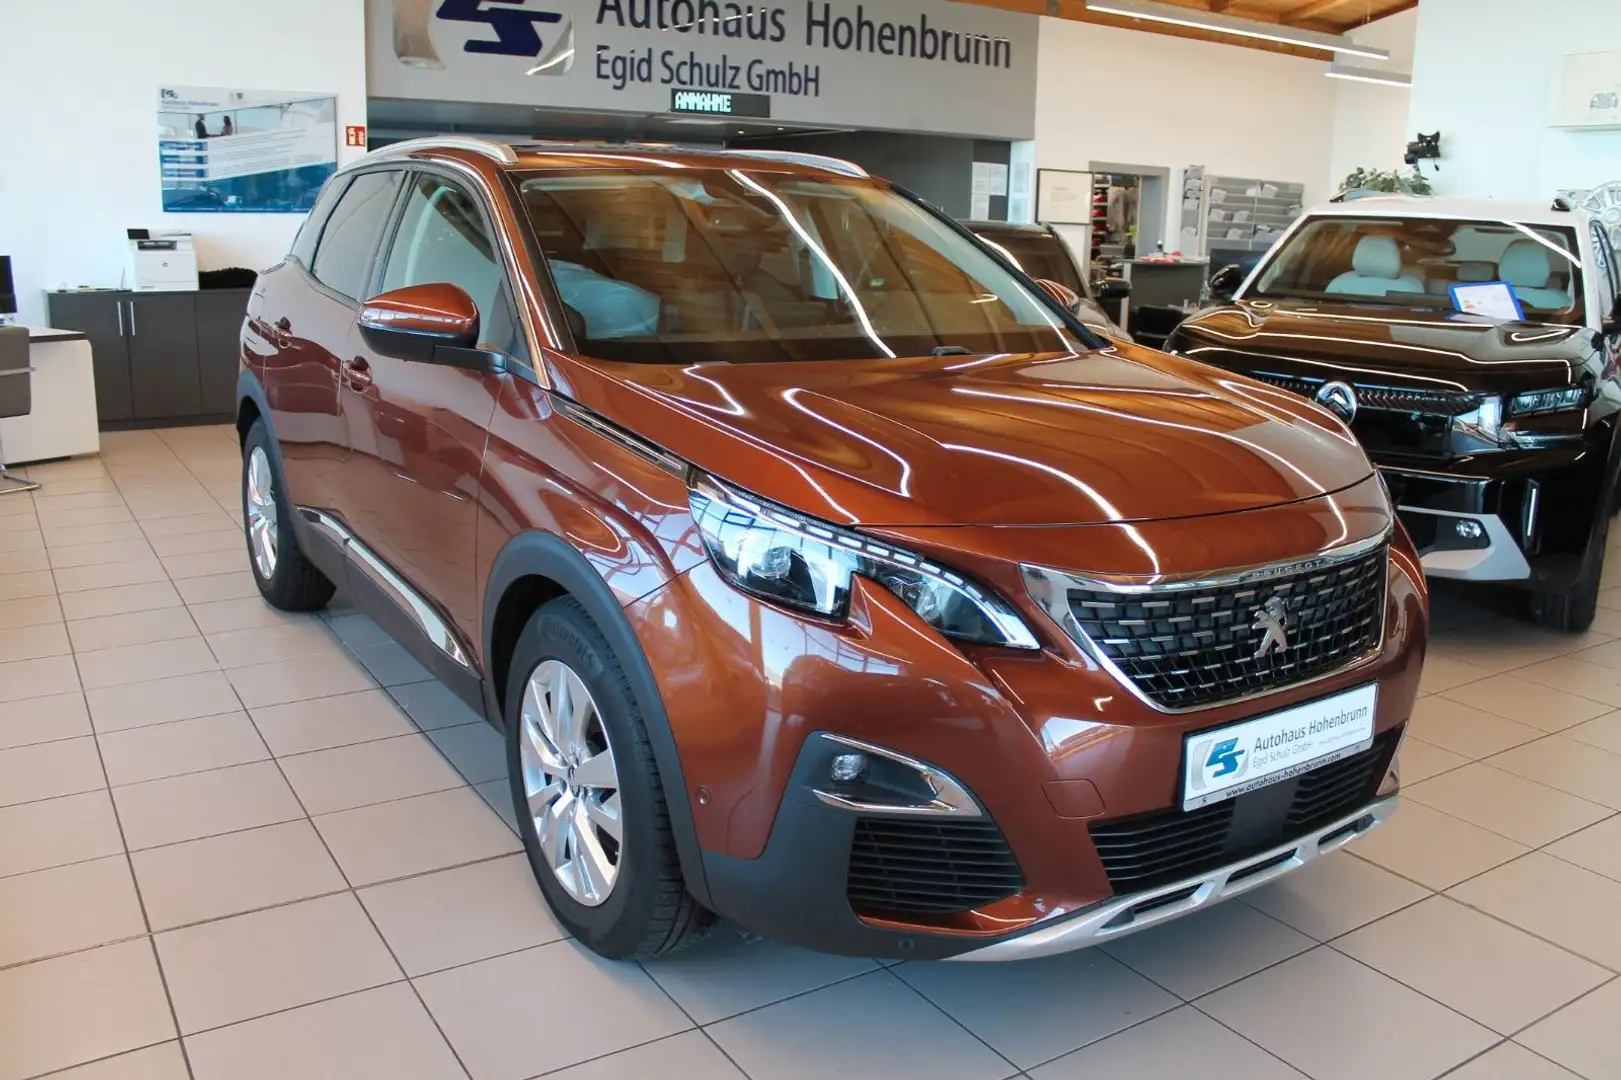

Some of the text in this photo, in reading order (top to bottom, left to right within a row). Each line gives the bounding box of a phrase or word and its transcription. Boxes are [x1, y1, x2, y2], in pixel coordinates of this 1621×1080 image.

[806, 1, 1011, 68] Hohenbrunn
[596, 45, 820, 97] Egid Schulz GmbH
[675, 91, 731, 113] ANNAHME
[1252, 559, 1322, 580] PEUGEOT
[1253, 725, 1306, 753] Autohaus
[1308, 705, 1368, 735] Hohenbrunn
[1252, 755, 1269, 769] Egid
[1269, 748, 1292, 765] Schulz
